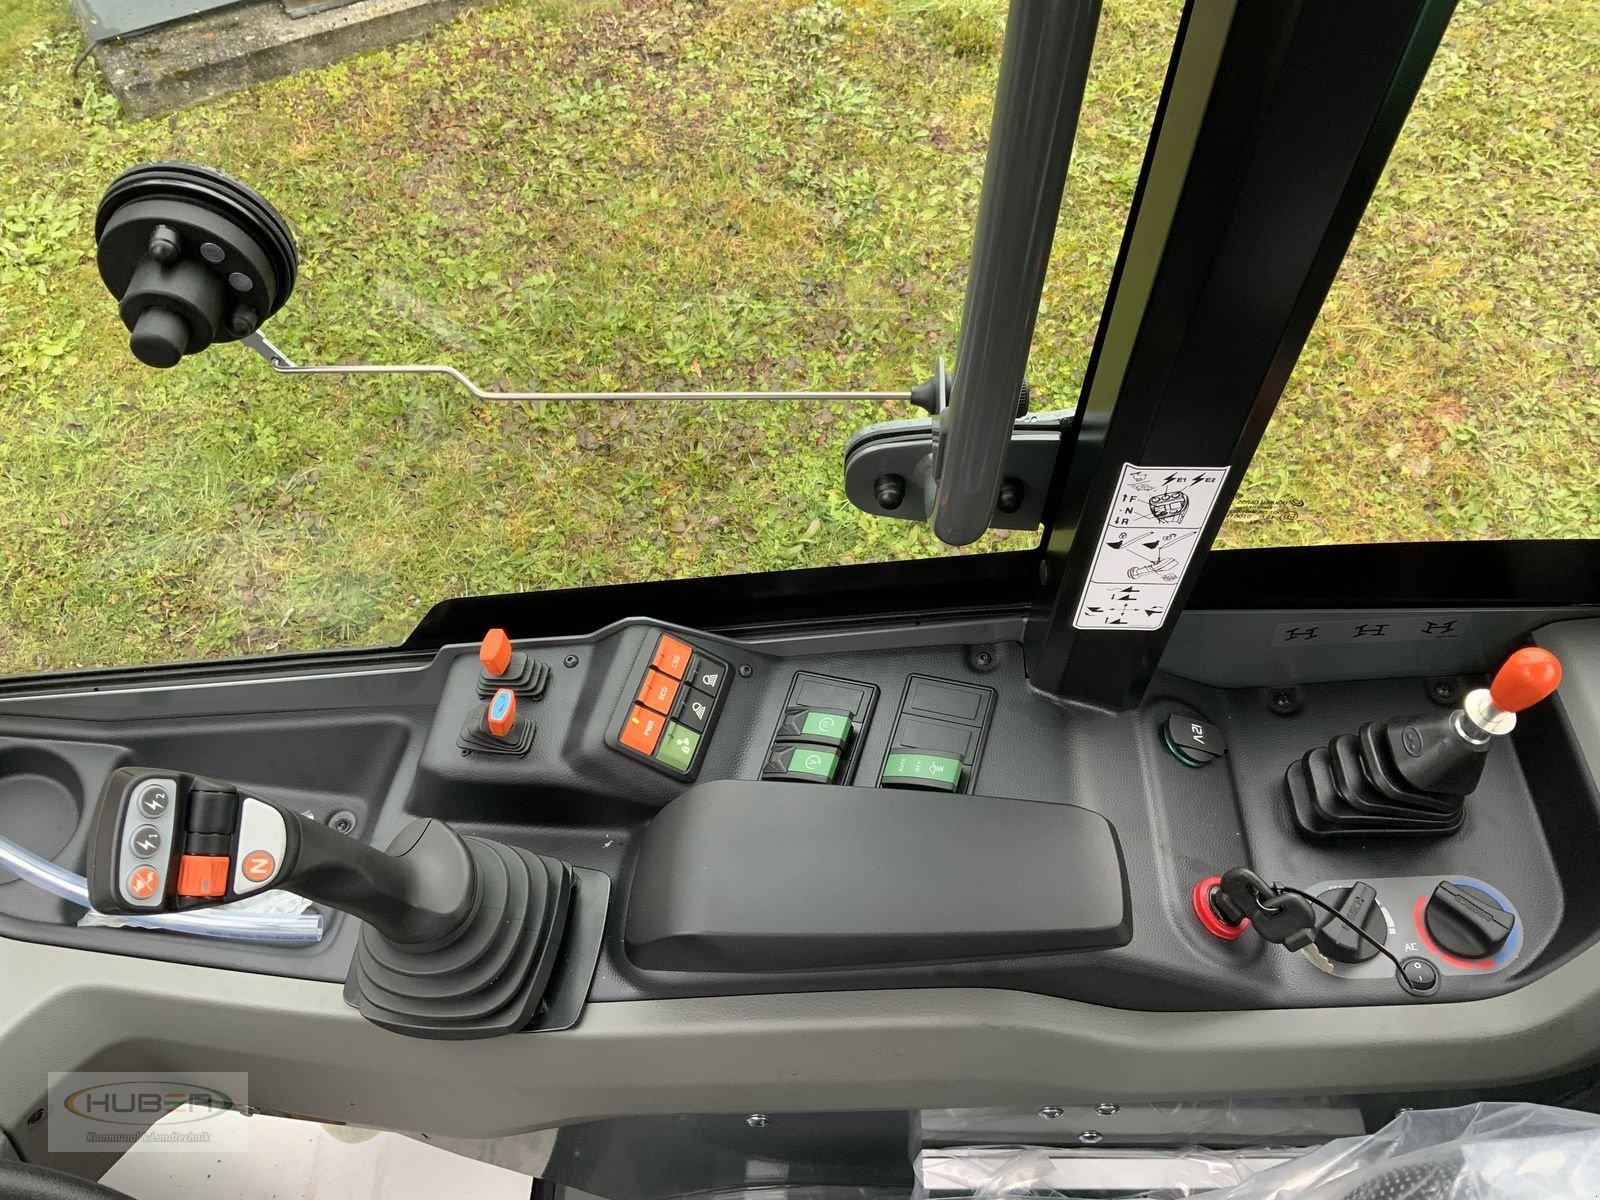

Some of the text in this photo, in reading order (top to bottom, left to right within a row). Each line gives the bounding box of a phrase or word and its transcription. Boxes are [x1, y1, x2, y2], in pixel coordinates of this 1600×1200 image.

[1129, 495, 1138, 503] F
[1124, 507, 1134, 515] N
[1120, 518, 1129, 526] R
[658, 686, 668, 701] ECO
[643, 719, 655, 737] PWR
[1191, 723, 1205, 745] 12V
[249, 858, 268, 875] N
